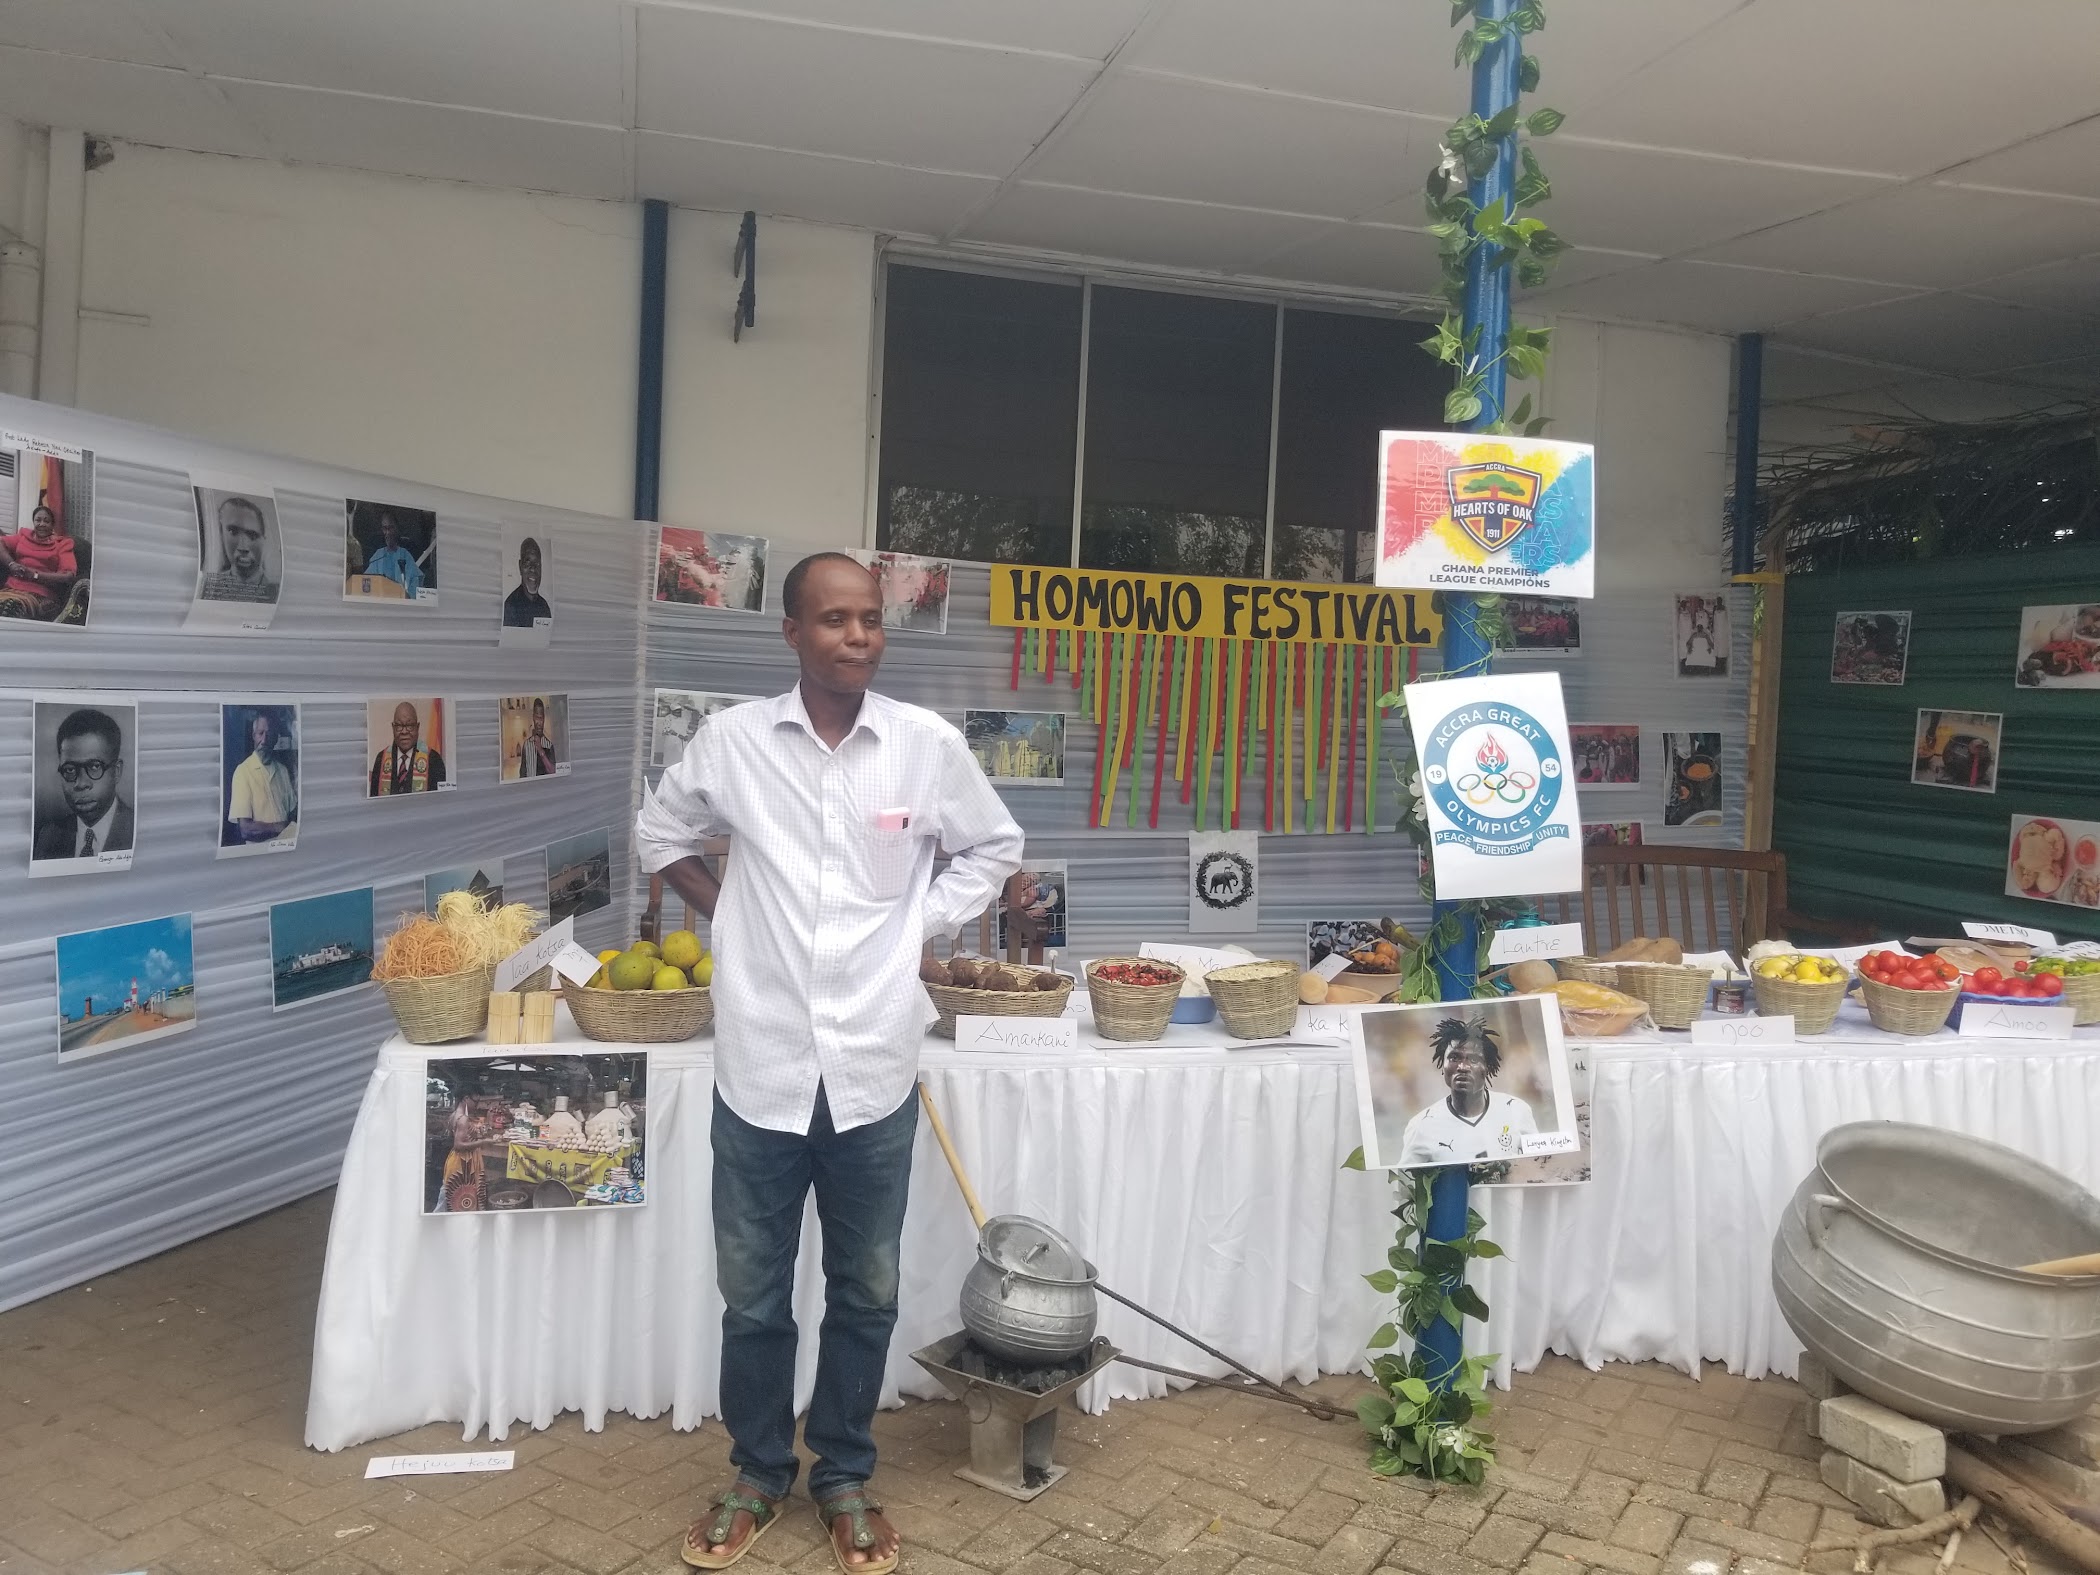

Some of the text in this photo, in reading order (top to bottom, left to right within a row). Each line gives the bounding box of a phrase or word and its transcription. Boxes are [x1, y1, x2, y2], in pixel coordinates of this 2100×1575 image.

[1485, 463, 1506, 472] ACCRA
[1453, 503, 1533, 522] HEARTS OF OAK
[1486, 528, 1500, 539] 1911
[1441, 564, 1539, 577] GHANA PREMIER
[1429, 574, 1550, 588] LEAGUE CHAMPIONS
[1009, 569, 1431, 645] HOMOWO FESTIVAL
[1435, 708, 1541, 748] ACCRA GREAT
[1430, 770, 1442, 779] 19
[1545, 763, 1557, 772] 54
[1446, 793, 1552, 835] OLYMPICS FC
[1436, 832, 1472, 846] PEACE
[1535, 826, 1566, 840] UNITY
[1475, 841, 1531, 855] FRIENDSHIP
